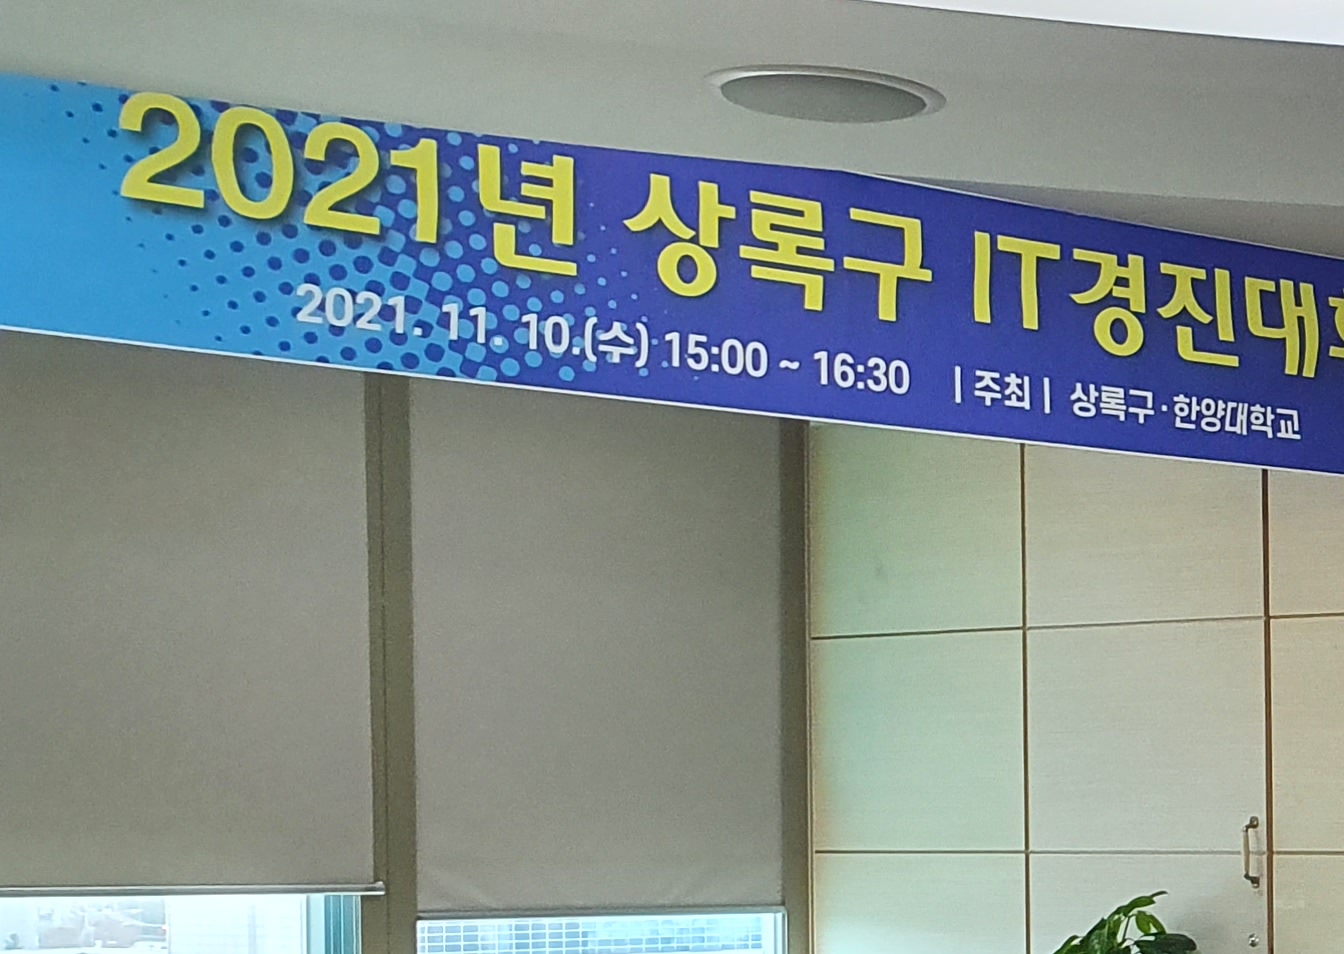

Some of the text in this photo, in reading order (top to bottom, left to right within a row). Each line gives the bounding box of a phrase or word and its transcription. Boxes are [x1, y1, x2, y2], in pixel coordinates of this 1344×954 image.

[118, 91, 578, 277] 2021년
[623, 172, 934, 323] 상록구
[295, 282, 424, 337] 2021.
[441, 302, 504, 347] 11.
[520, 311, 649, 369] 10.(수)
[664, 331, 769, 379] 15:00
[813, 349, 911, 396] 16:30
[972, 370, 1032, 412] 주최
